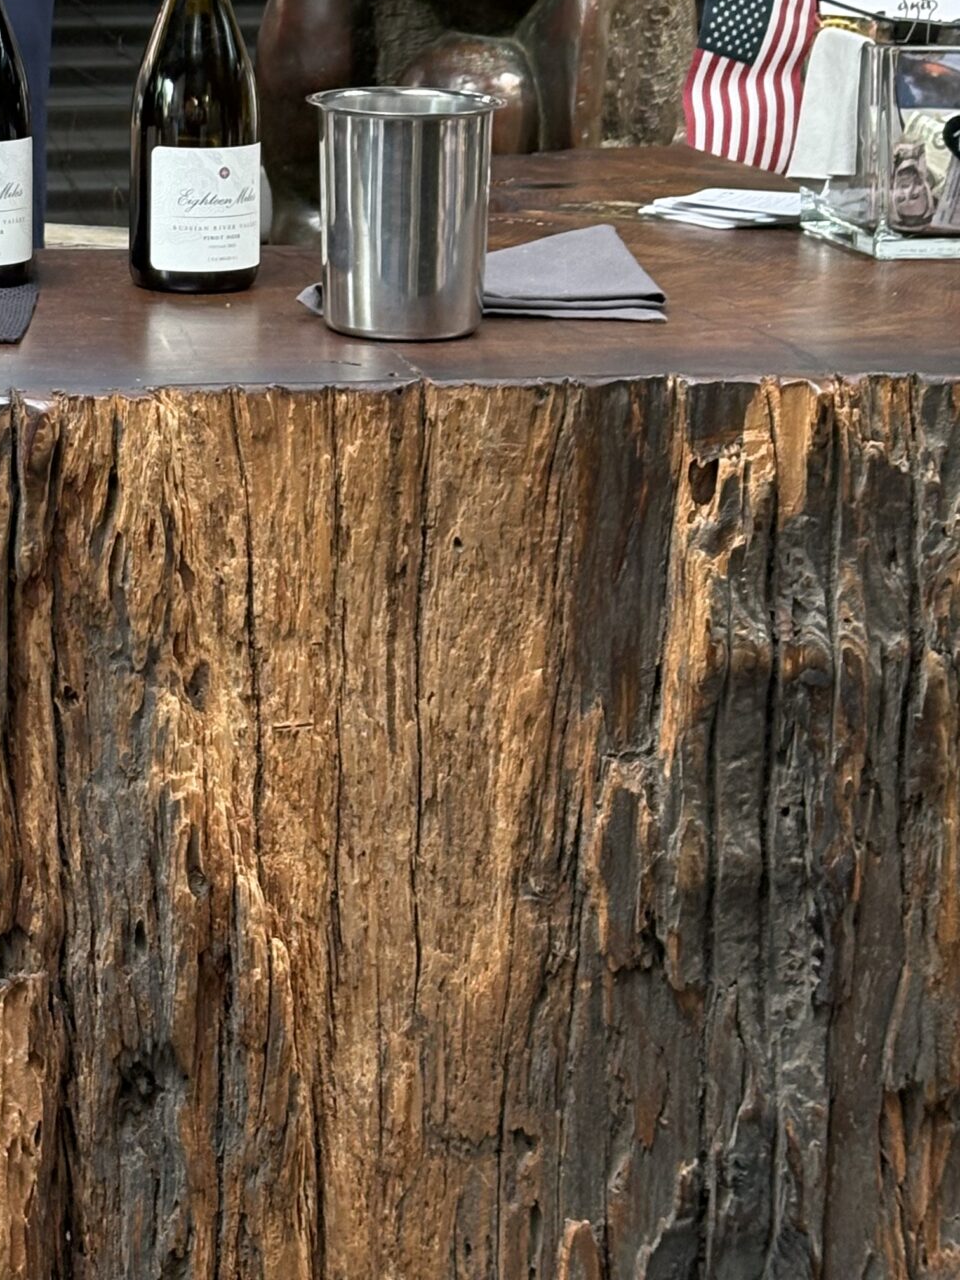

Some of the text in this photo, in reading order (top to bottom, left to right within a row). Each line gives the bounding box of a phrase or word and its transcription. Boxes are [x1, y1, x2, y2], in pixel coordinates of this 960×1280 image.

[177, 188, 232, 212] Eighteen
[2, 216, 26, 225] VALLEY
[172, 224, 209, 232] RUSSIAN
[212, 223, 237, 231] RIVER
